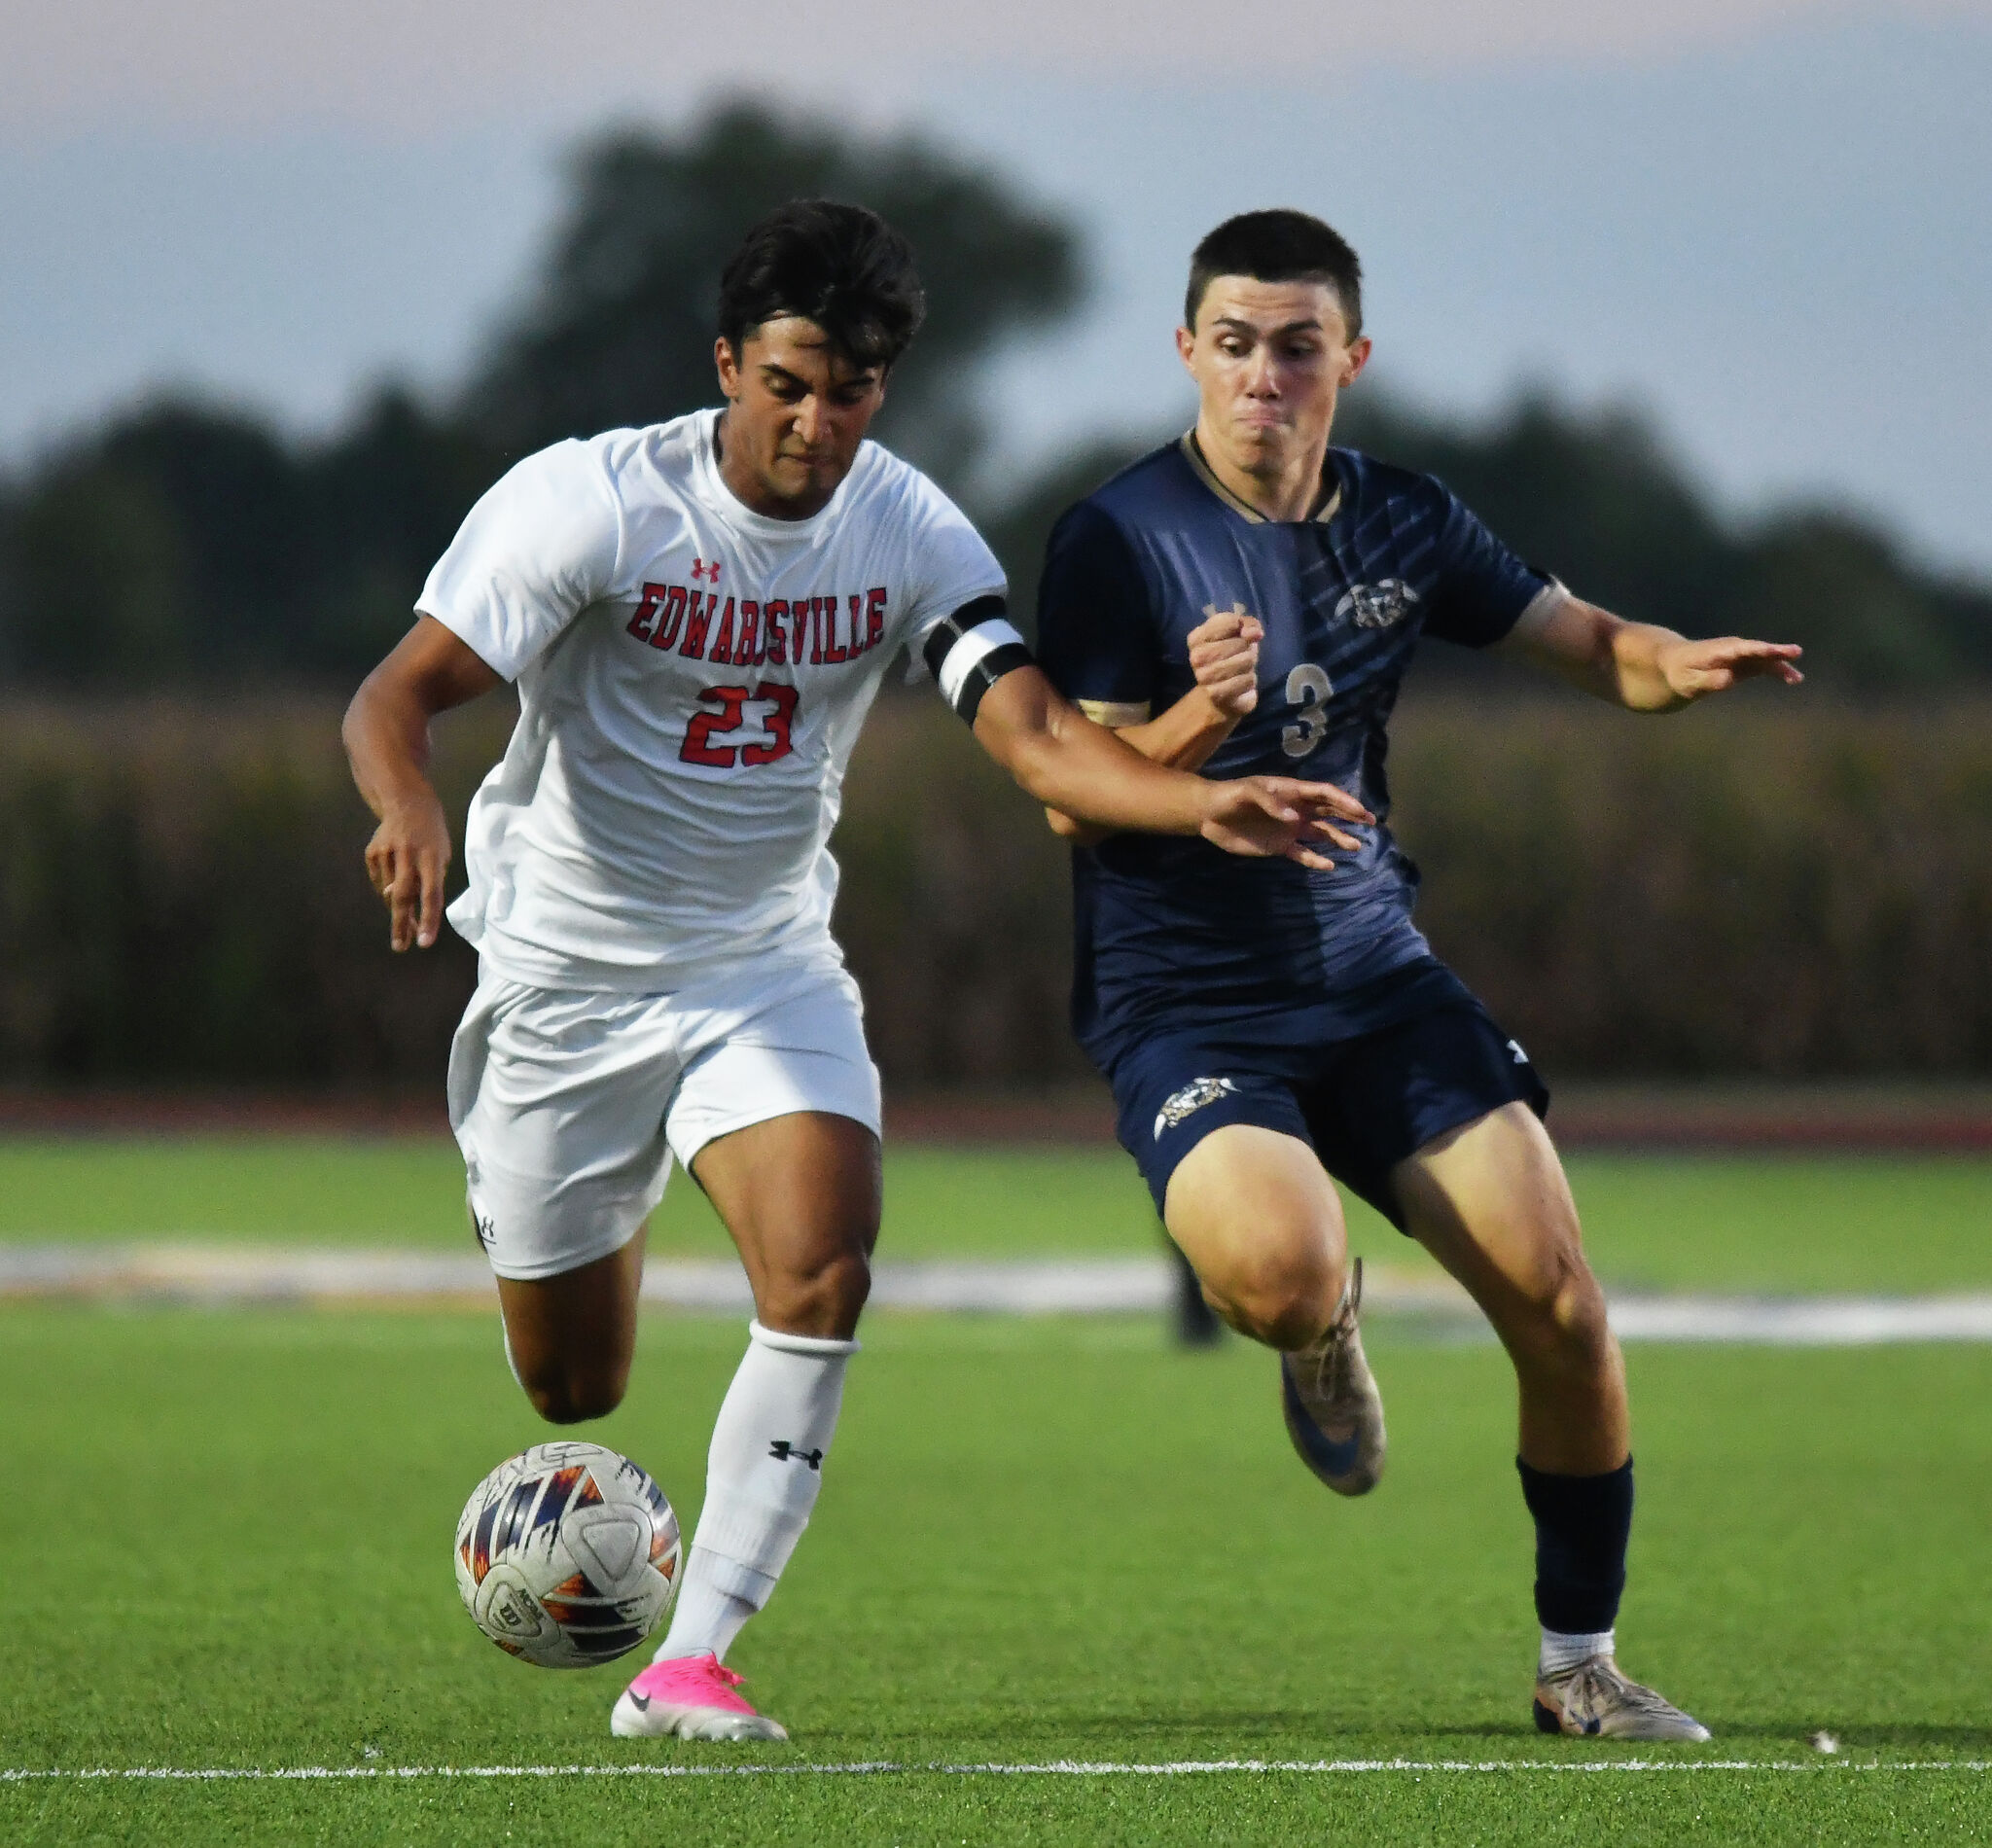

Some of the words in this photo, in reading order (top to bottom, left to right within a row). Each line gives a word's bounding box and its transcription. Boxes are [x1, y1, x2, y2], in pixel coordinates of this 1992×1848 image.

[626, 582, 887, 665] EDWARSVILLE
[679, 681, 800, 768] 23
[1282, 662, 1334, 758] 3
